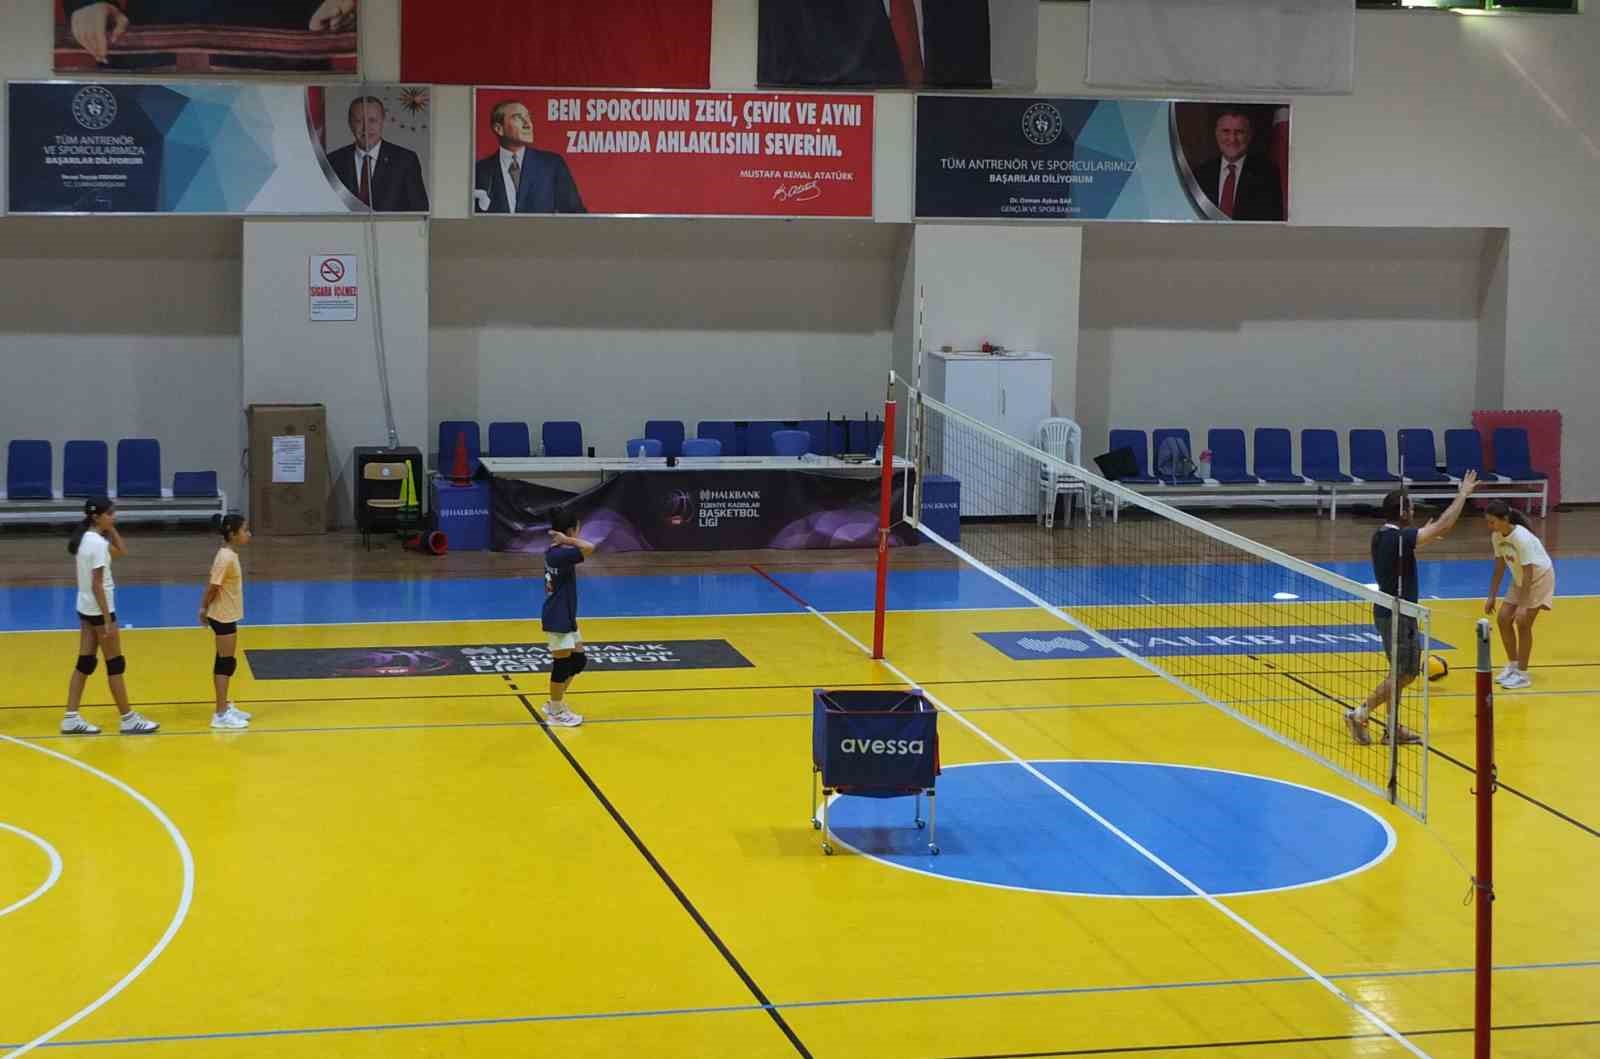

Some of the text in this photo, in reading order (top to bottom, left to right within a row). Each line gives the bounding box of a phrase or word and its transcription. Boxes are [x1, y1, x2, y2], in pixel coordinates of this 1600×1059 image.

[548, 95, 861, 129] BEN SPORCUNUN ZEKİ, ÇEVİK VE AYNI
[566, 128, 842, 157] ZAMANDA AHLAKLISINI SEVERİM.
[940, 157, 966, 170] TÜM
[968, 158, 1028, 171] ANTRENÖR
[1031, 160, 1045, 170] VE
[740, 169, 853, 181] MUSTAFA KEMAL ATATÜRK
[989, 173, 1093, 184] BAŞARILAR DİLİYORUM
[712, 491, 760, 499] HALKBANK
[700, 509, 760, 517] BASKETBOL
[501, 643, 666, 654] HABANK
[840, 739, 924, 754] avessa
